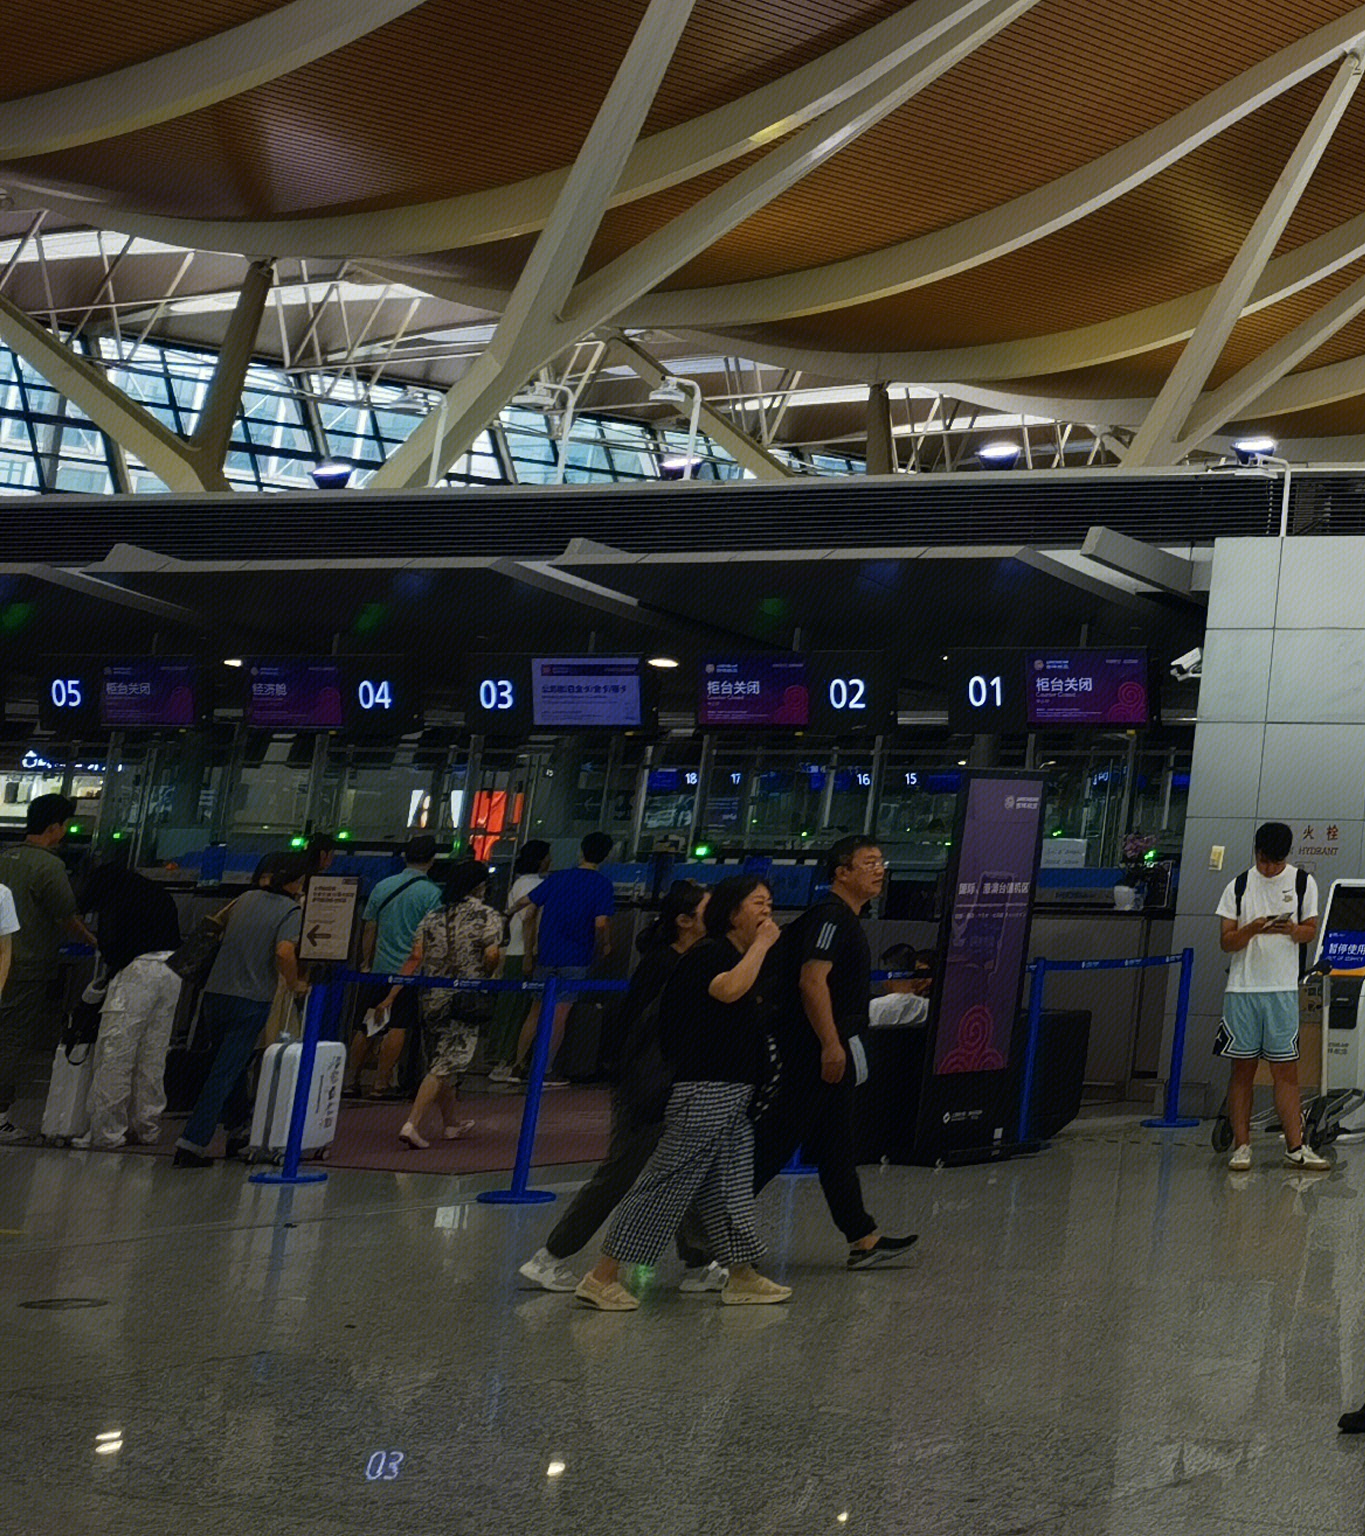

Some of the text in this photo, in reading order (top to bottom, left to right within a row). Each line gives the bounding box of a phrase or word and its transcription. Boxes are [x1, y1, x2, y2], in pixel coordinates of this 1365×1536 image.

[707, 680, 760, 695] 柜台关闭
[968, 675, 1002, 708] 01
[1035, 677, 1093, 692] 柜台关闭
[51, 679, 82, 707] 05
[358, 680, 392, 709] 04
[479, 679, 514, 709] 03
[829, 678, 867, 710] 02
[684, 773, 698, 785] 18
[730, 773, 741, 784] 17
[856, 773, 870, 785] 16
[904, 773, 917, 785] 15
